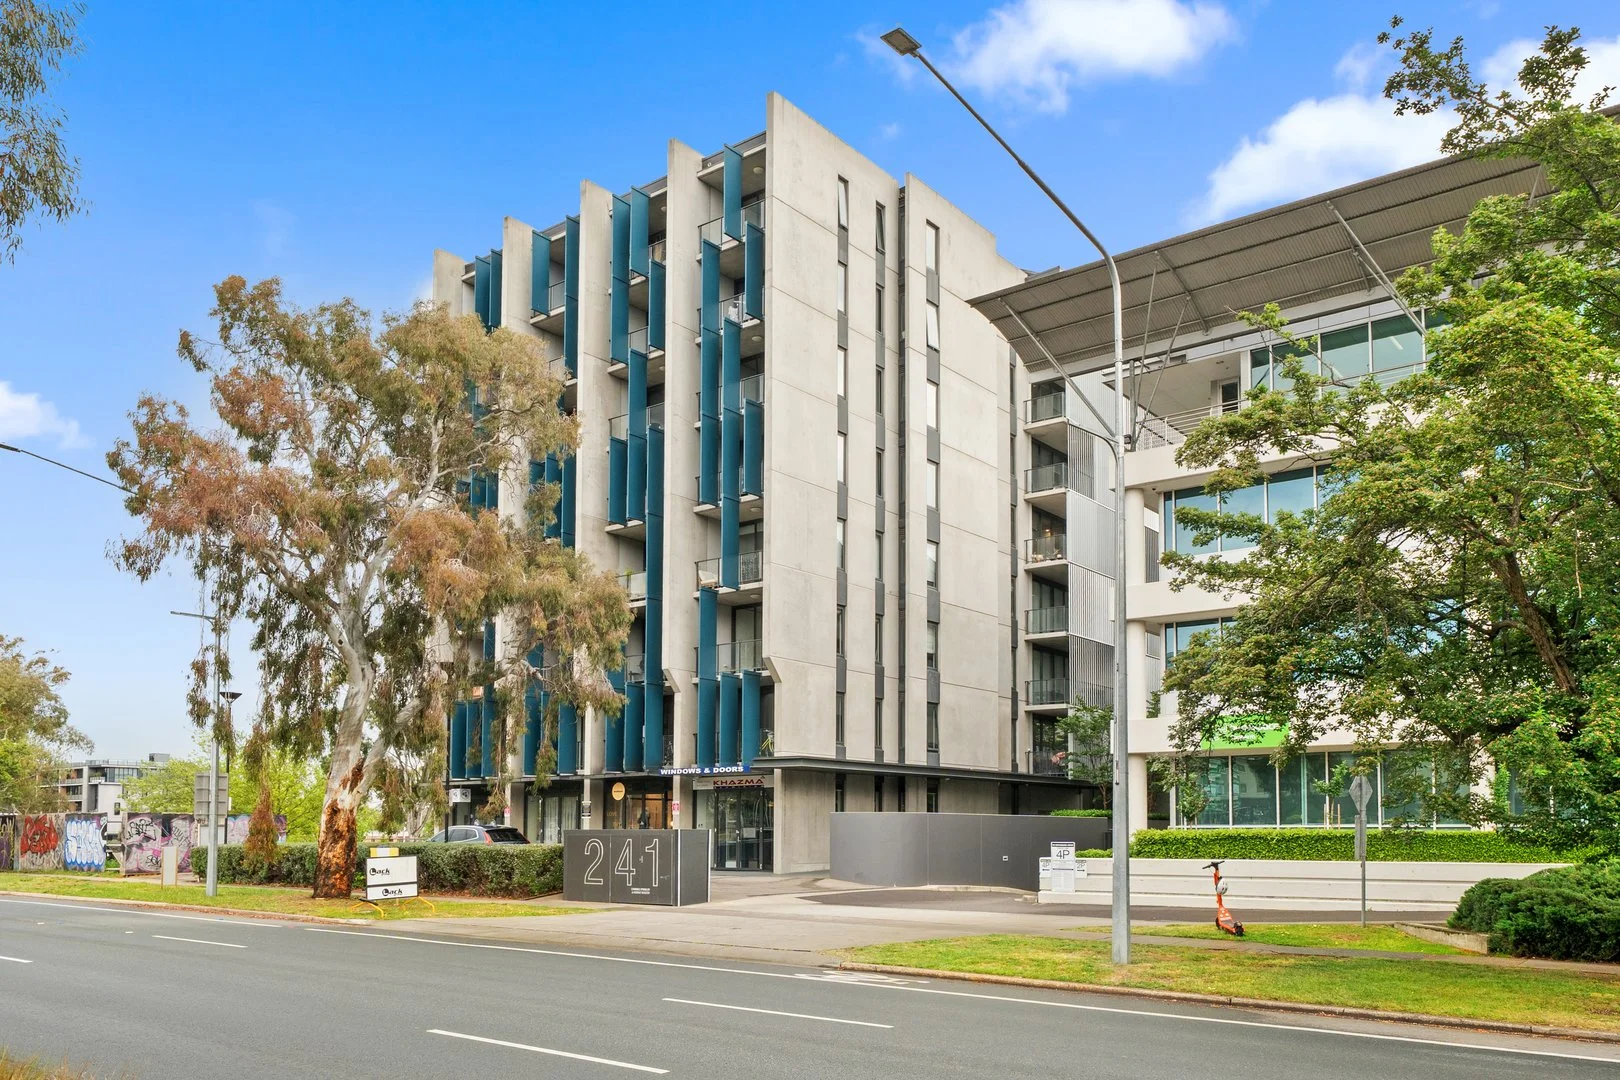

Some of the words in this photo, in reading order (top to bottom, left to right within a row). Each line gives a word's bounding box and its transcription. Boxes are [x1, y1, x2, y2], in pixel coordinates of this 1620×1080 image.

[713, 765, 744, 773] DOORS
[713, 778, 764, 786] KHAZMA
[1056, 850, 1070, 859] 4P
[584, 838, 658, 887] 241
